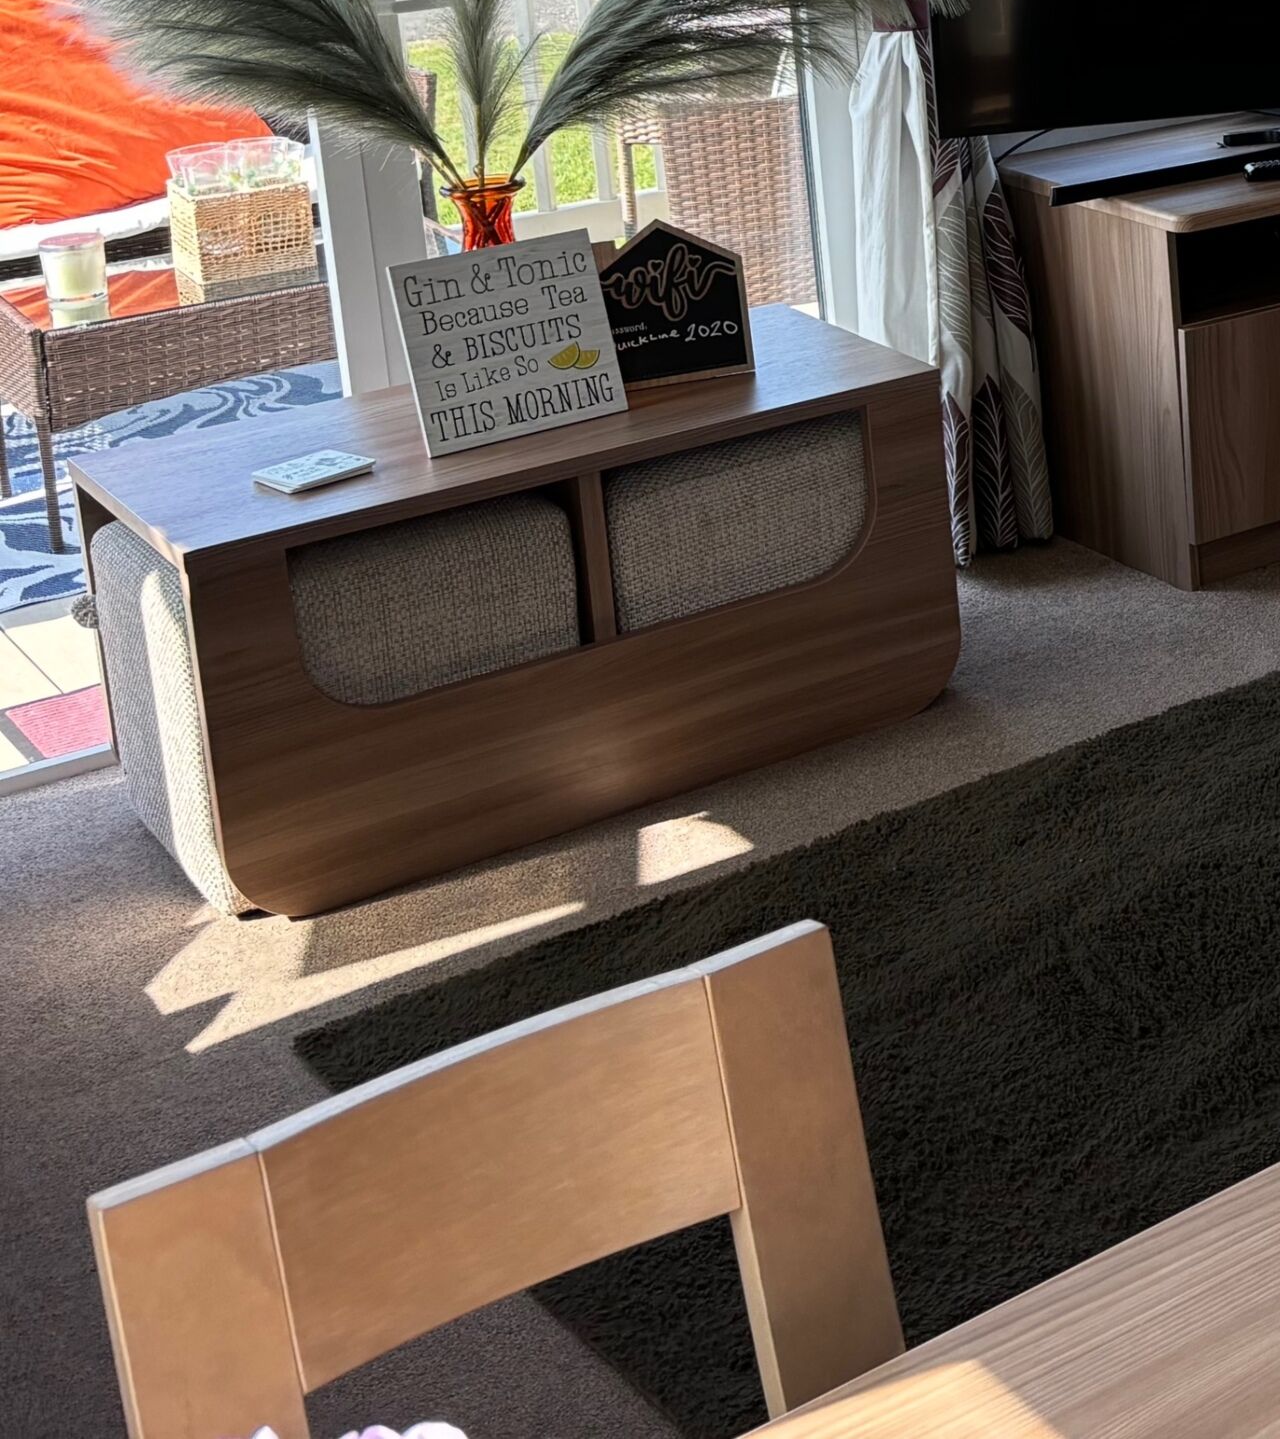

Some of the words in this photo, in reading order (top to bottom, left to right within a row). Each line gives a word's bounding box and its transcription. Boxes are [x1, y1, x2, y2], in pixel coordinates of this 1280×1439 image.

[404, 275, 465, 308] Gin
[470, 263, 495, 294] &
[497, 251, 588, 288] Tonic
[600, 243, 738, 322] wifi
[419, 297, 530, 336] Because
[541, 285, 588, 310] Tea
[685, 321, 738, 342] 2020
[432, 343, 455, 369] &
[463, 313, 583, 361] BISCUITS
[435, 380, 458, 402] Is
[461, 366, 511, 394] Like
[514, 356, 539, 377] So
[430, 401, 496, 443] THIS
[503, 373, 614, 426] MORNING
